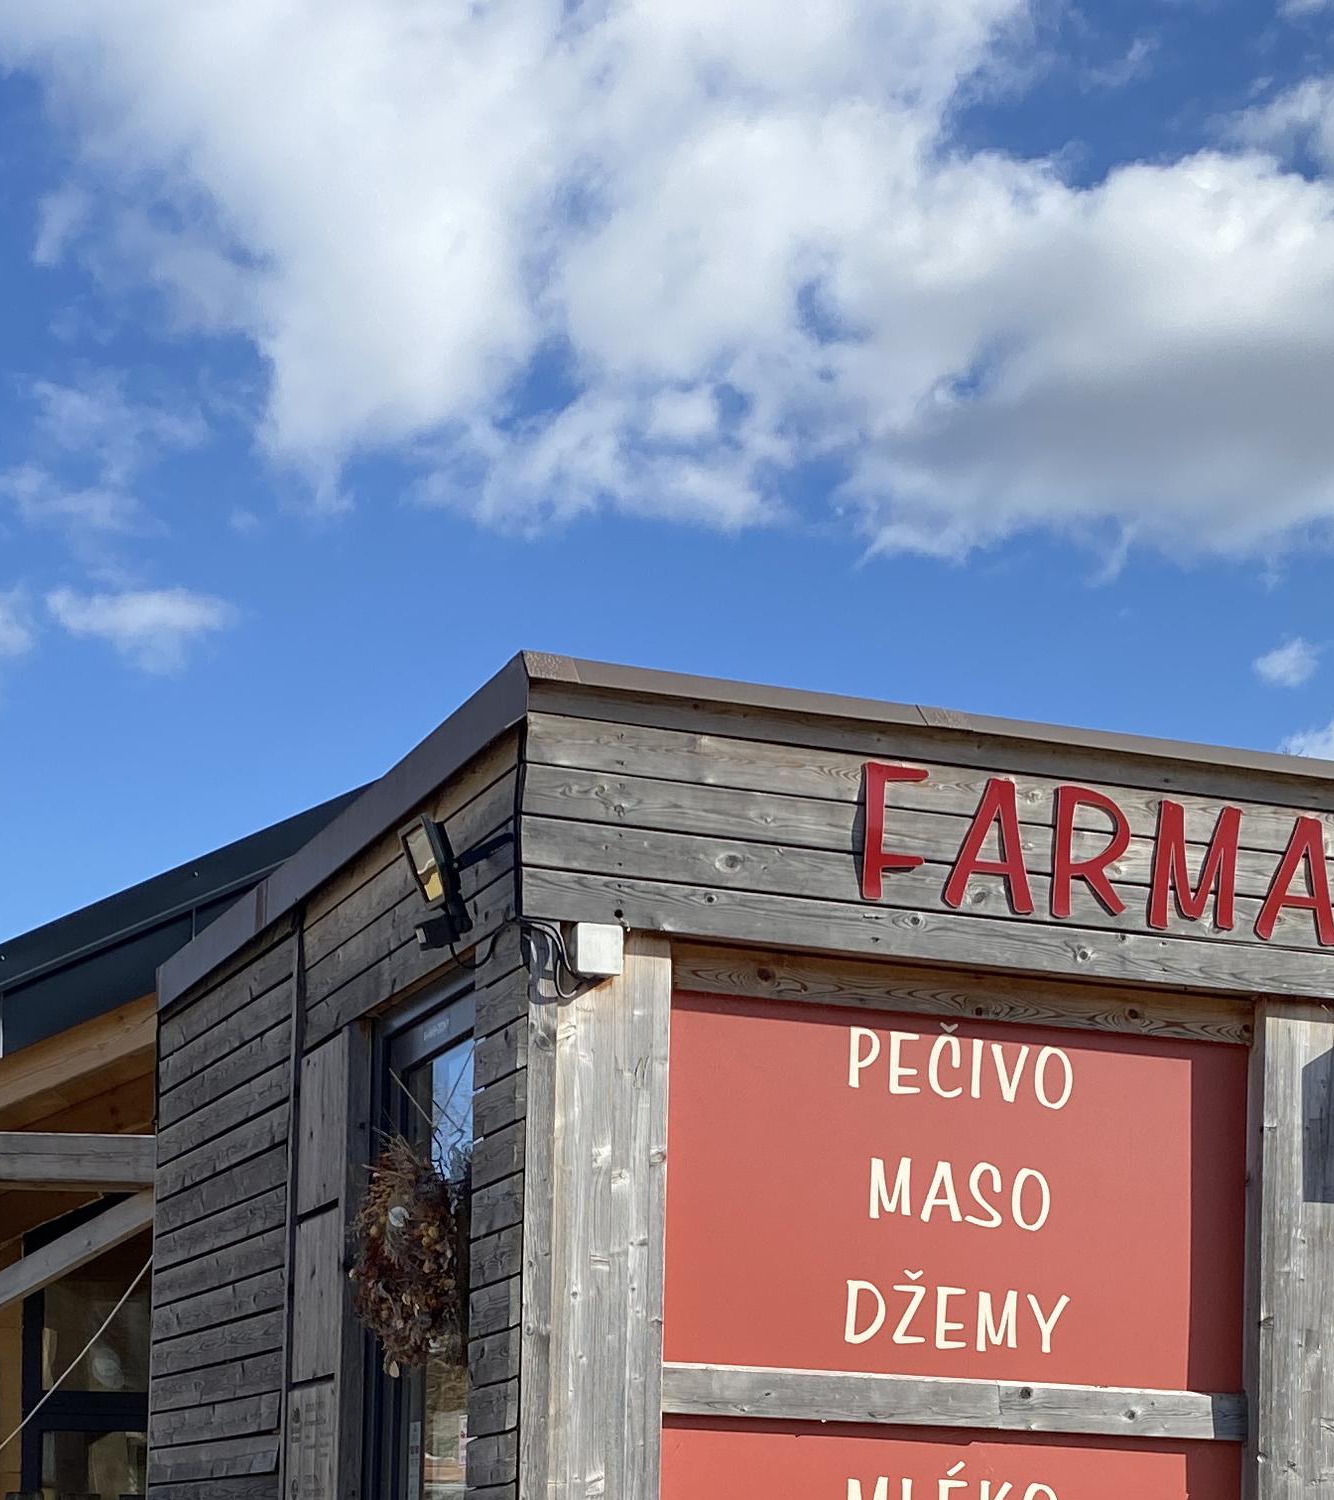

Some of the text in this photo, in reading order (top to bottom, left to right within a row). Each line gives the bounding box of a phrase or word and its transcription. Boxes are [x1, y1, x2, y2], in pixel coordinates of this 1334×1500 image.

[847, 1022, 1074, 1110] PEČIVO
[869, 1156, 1051, 1232] MASO
[844, 1269, 1070, 1354] DŽEMY
